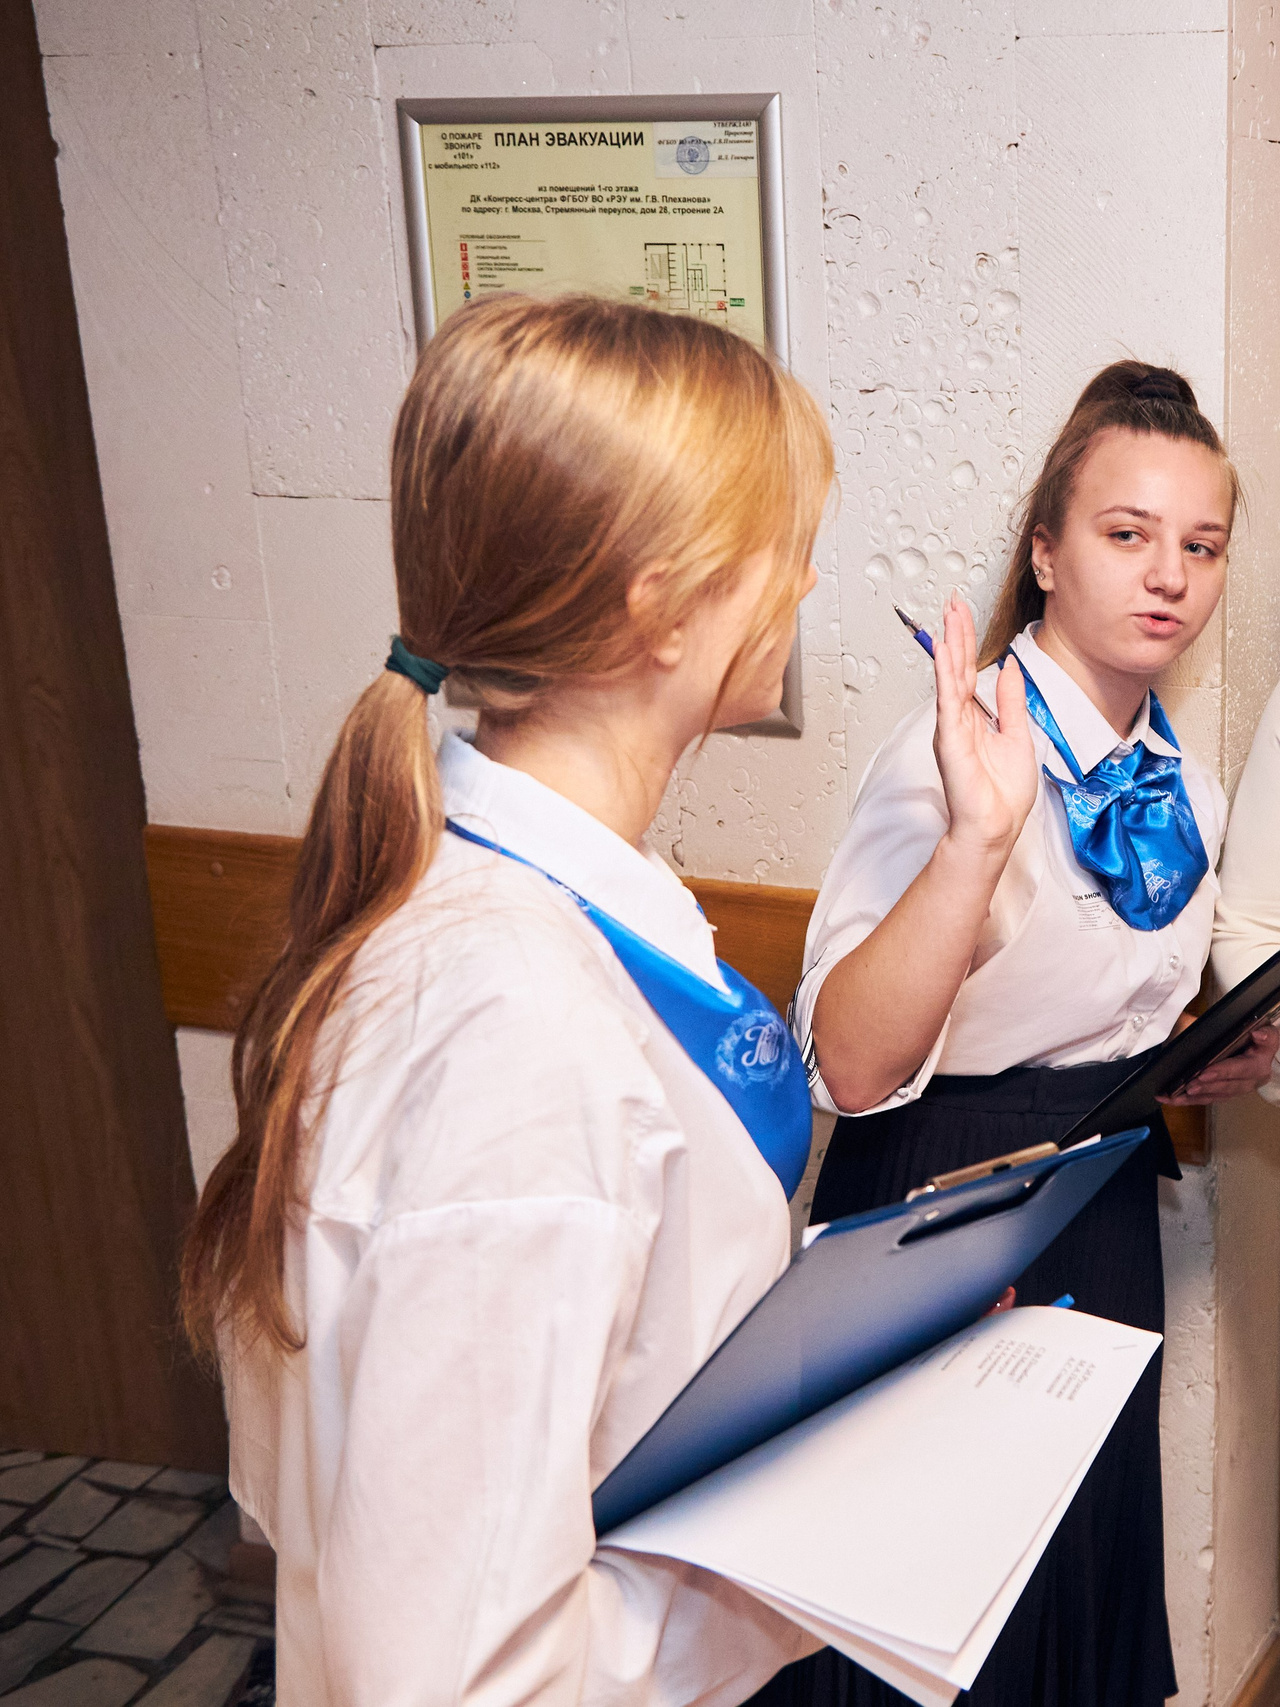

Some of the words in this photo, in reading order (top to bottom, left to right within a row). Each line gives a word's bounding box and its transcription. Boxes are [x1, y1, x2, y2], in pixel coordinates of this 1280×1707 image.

[495, 133, 539, 146] ПЛАН
[545, 132, 644, 148] ЭВАКУАЦИИ
[550, 184, 595, 193] помещений
[484, 195, 557, 204] «Конгресс-центра»
[560, 195, 588, 203] ФГБОУ
[592, 195, 603, 203] ВО
[606, 195, 626, 203] «РЭУ
[512, 206, 543, 214] Москва,
[545, 206, 596, 214] Стремянный
[599, 207, 638, 215] переулок,
[713, 206, 724, 214] 2А
